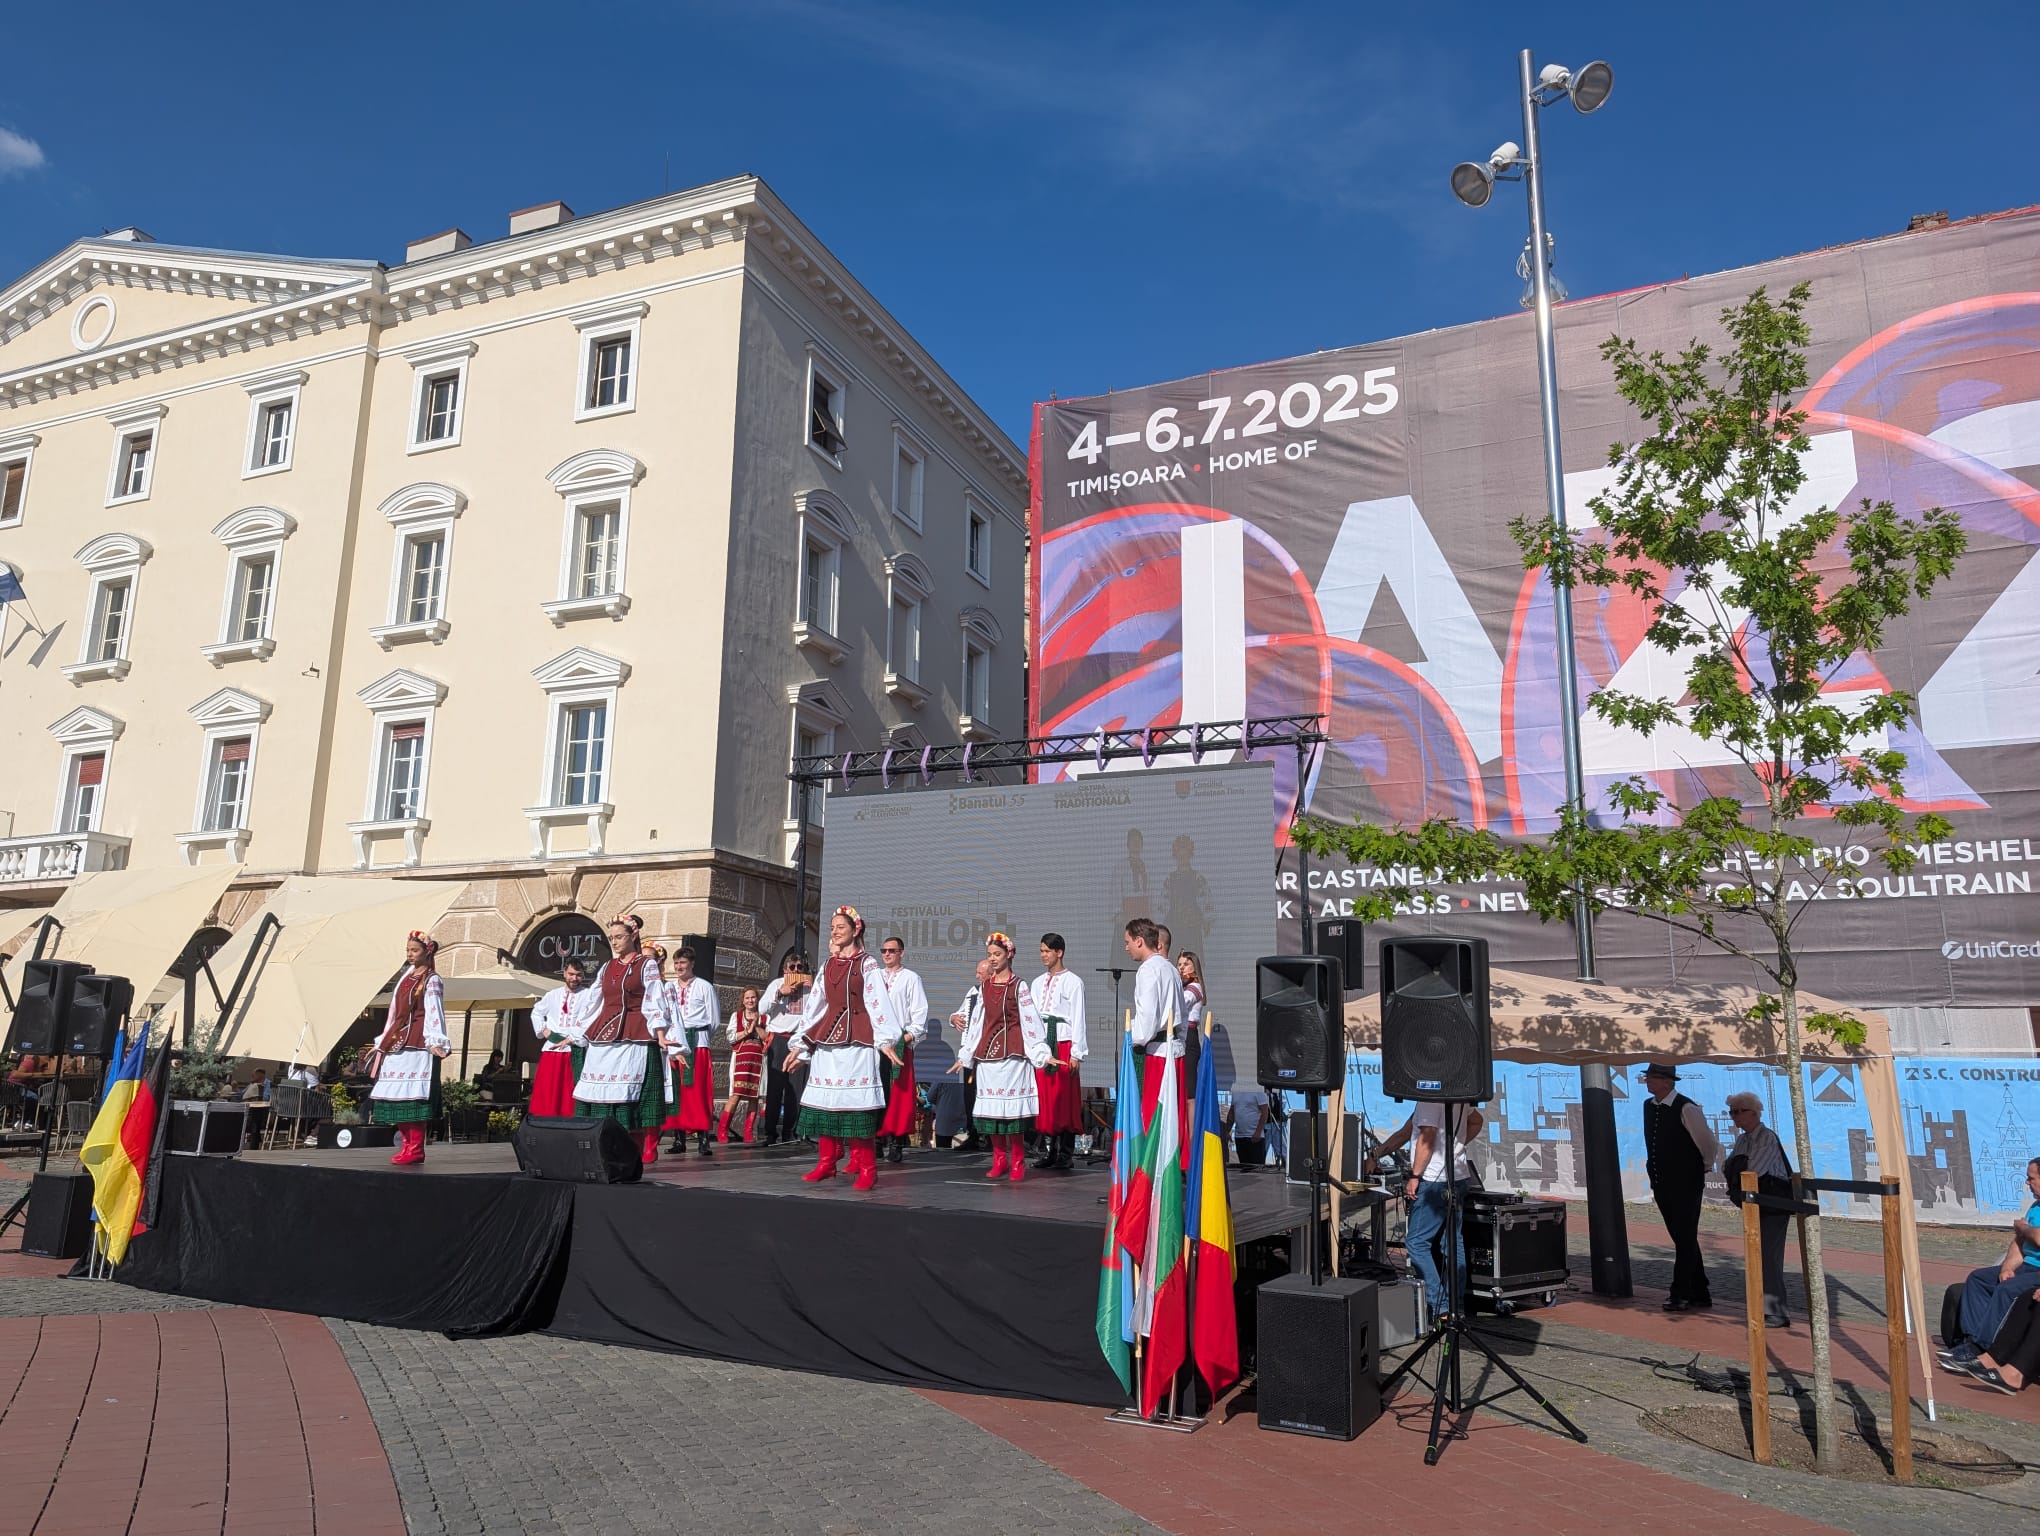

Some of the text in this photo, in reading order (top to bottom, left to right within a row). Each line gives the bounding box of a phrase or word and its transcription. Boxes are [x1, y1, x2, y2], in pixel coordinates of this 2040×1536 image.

[1210, 446, 1278, 474] HOME
[1284, 440, 1318, 461] OF
[1904, 838, 2040, 865] MESHEL
[1836, 871, 2032, 899] SOULTRAIN
[891, 905, 954, 918] FESTIVALUL
[538, 934, 602, 959] CULT
[1922, 1067, 1954, 1080] S.C.
